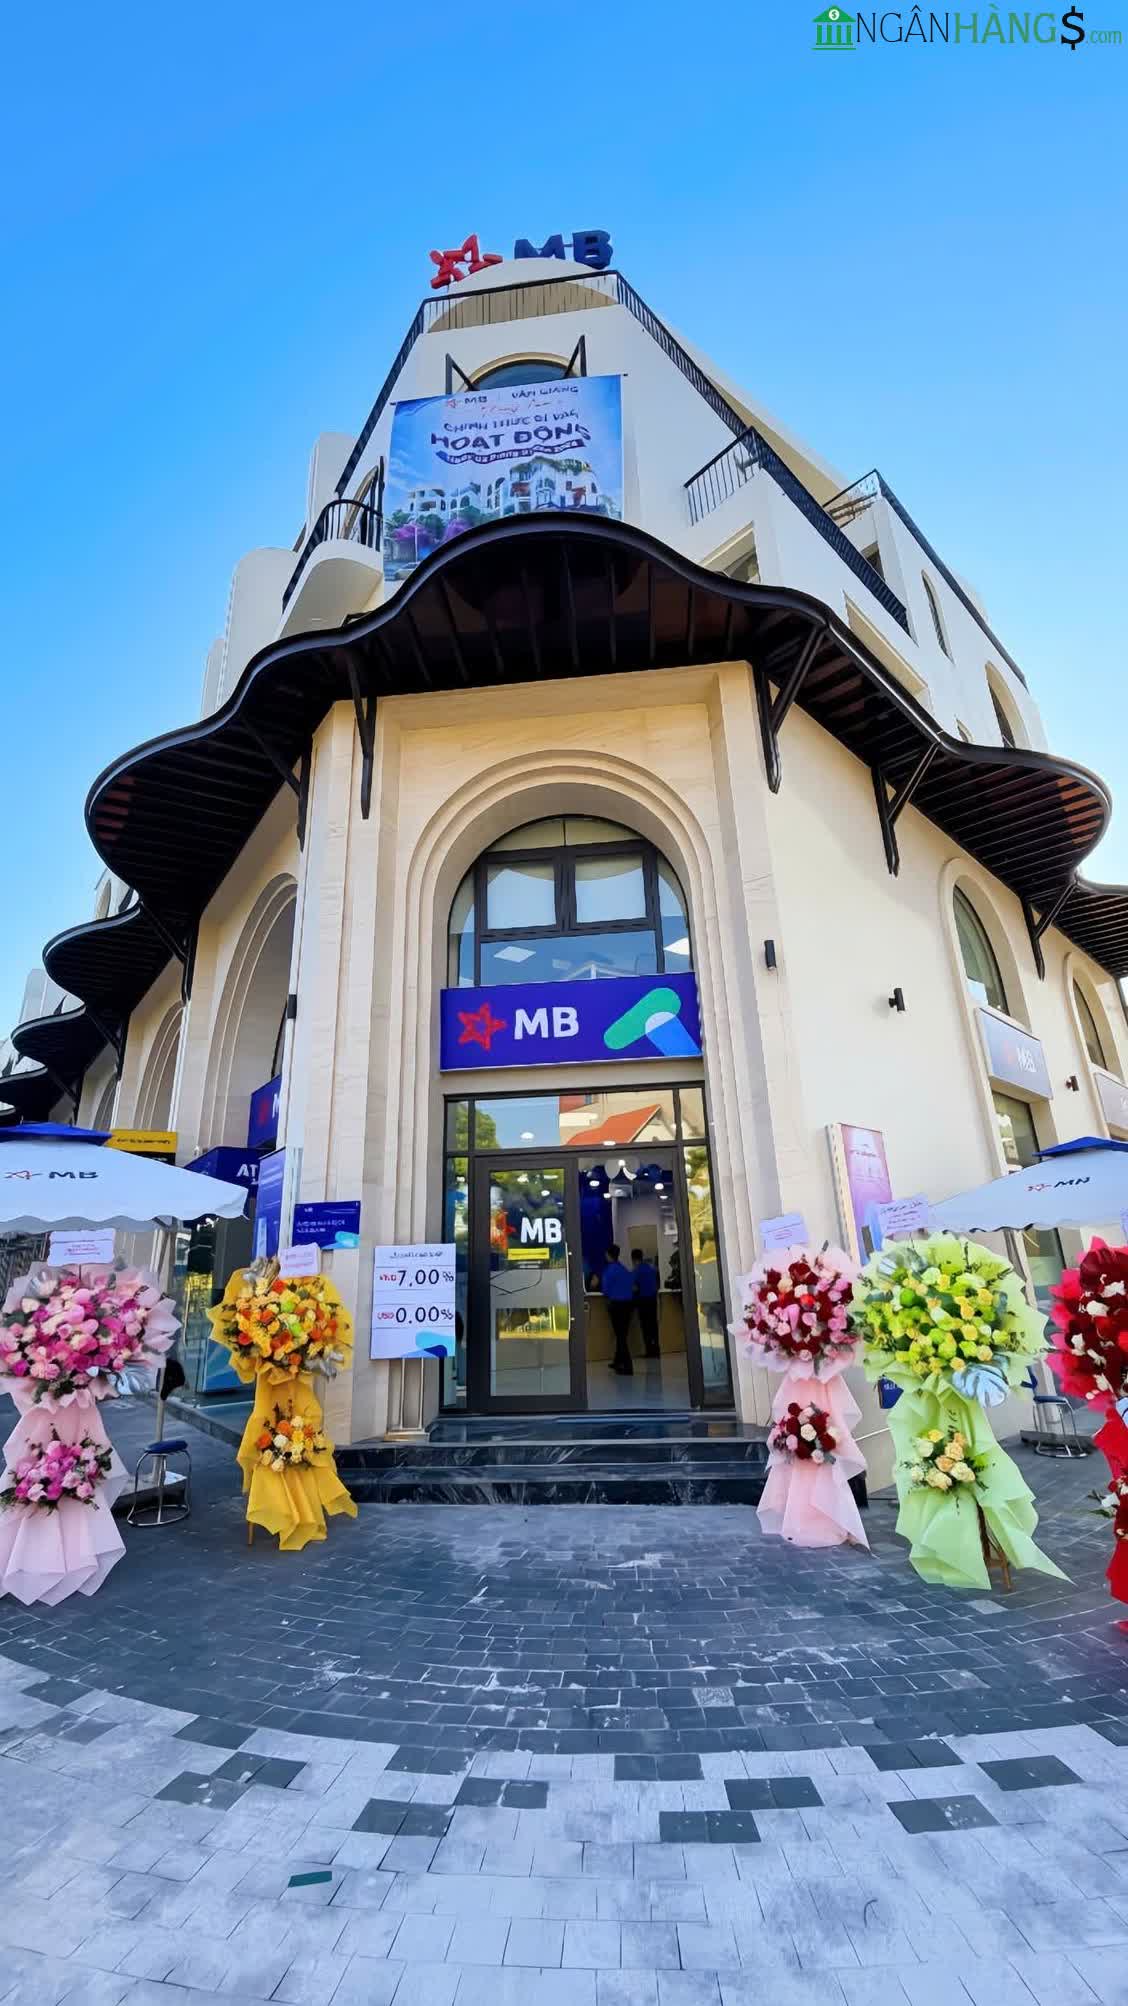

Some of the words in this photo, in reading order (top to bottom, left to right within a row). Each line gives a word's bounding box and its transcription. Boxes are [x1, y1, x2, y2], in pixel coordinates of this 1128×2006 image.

[515, 230, 613, 270] MB
[514, 1006, 579, 1040] MB
[49, 1171, 99, 1179] MB
[236, 1163, 258, 1178] AT
[521, 1216, 562, 1243] MB
